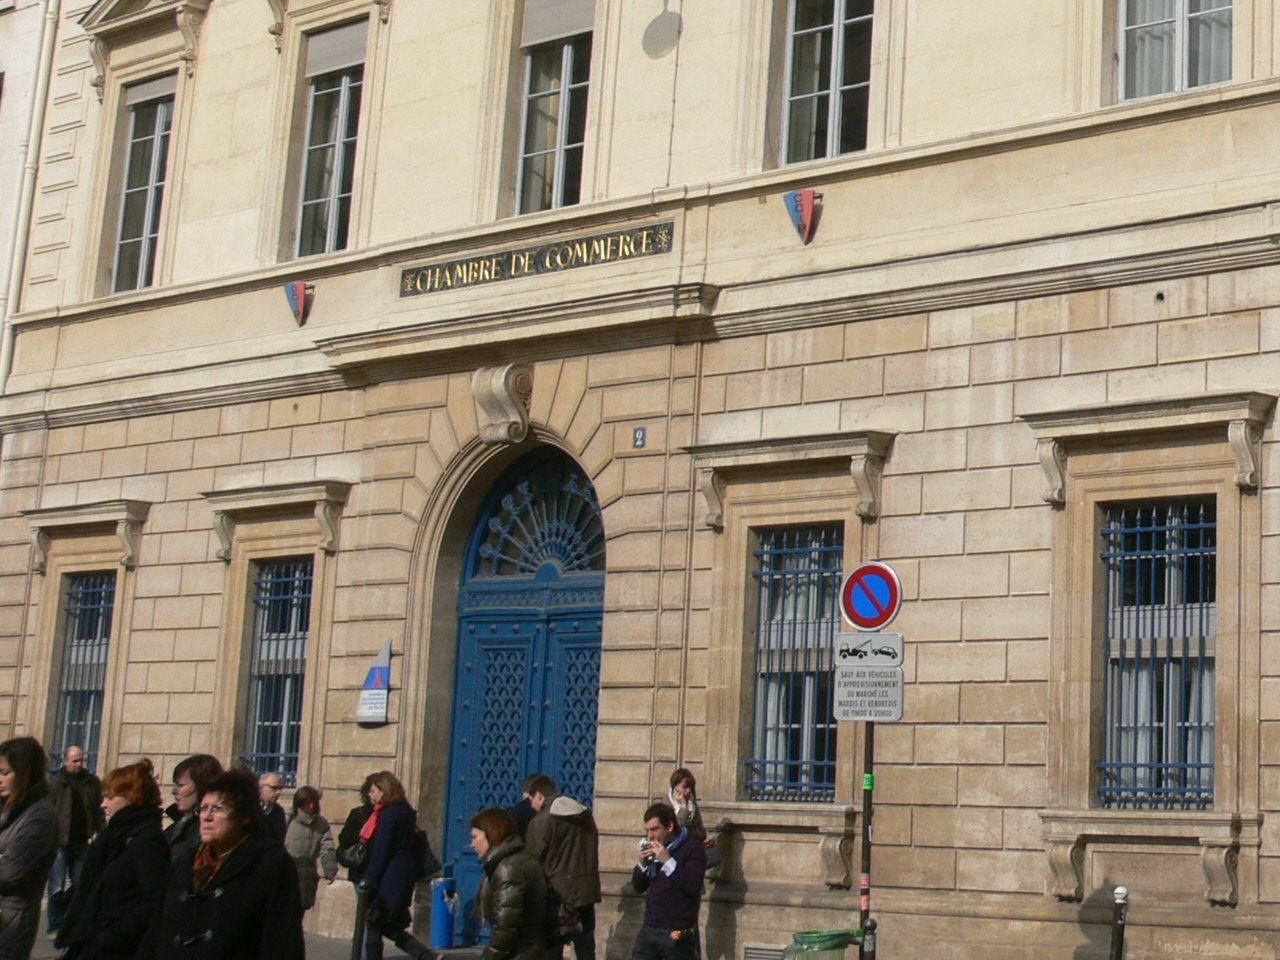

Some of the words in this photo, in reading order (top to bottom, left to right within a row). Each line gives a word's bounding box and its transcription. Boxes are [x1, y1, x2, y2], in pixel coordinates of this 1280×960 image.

[415, 257, 502, 290] CHAMBRE
[511, 251, 535, 276] DE
[545, 229, 654, 269] COMMERCE
[636, 430, 643, 446] 2
